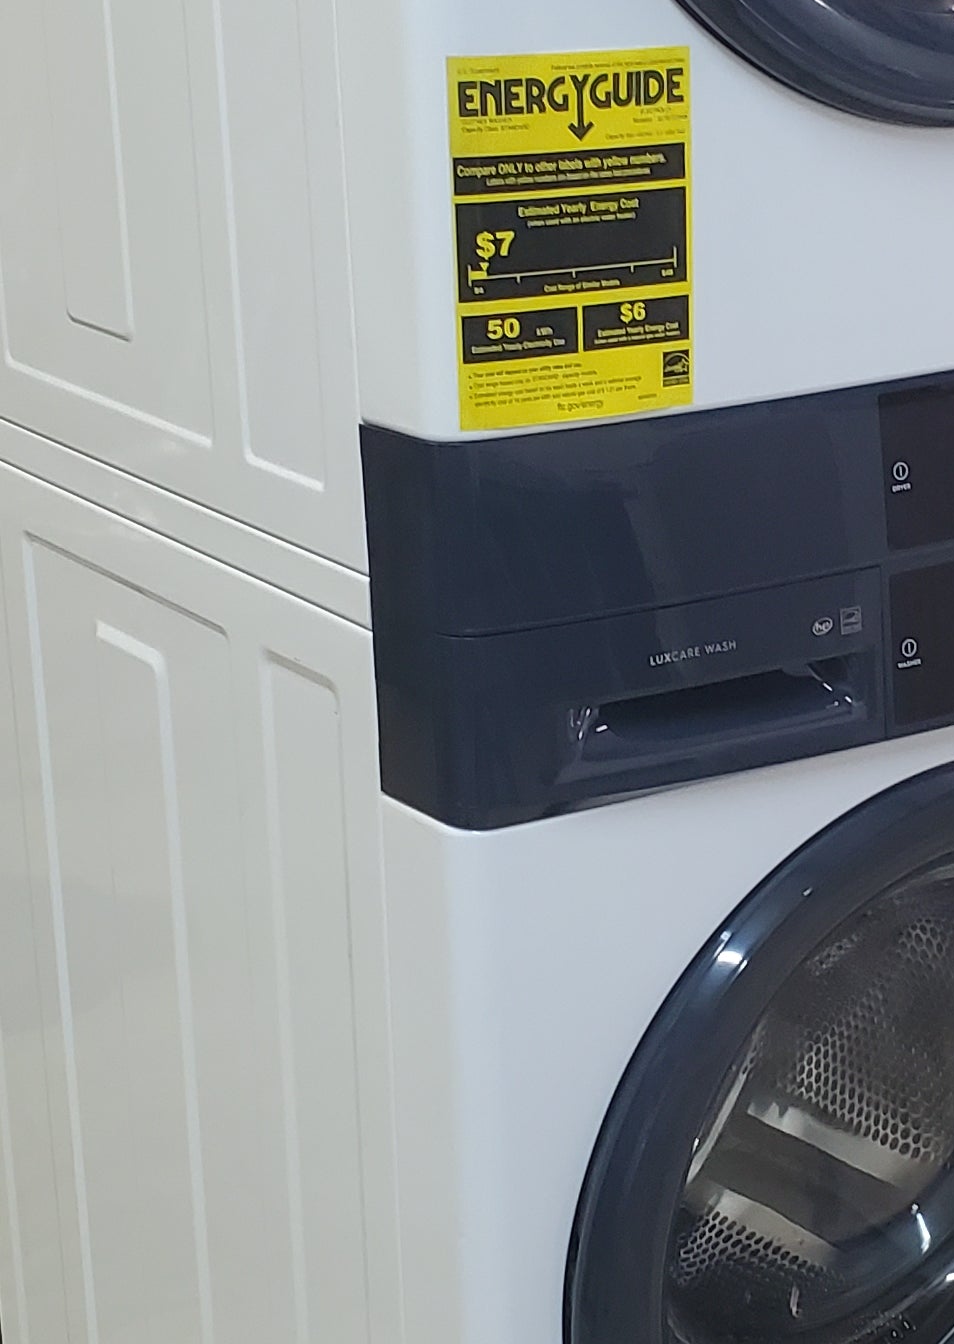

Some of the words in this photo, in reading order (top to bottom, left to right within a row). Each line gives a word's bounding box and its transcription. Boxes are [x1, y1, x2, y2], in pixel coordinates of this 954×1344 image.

[457, 67, 685, 120] ENERGYGUIDE
[457, 165, 497, 179] Compare
[498, 162, 523, 175] ONLY
[524, 163, 534, 173] to
[535, 161, 557, 172] other
[561, 202, 587, 215] Yearly
[590, 200, 618, 212] Energy
[620, 198, 639, 209] Cost
[476, 230, 515, 260] $7
[620, 301, 646, 324] $6
[487, 317, 520, 340] 50
[649, 646, 701, 667] LUXCARE
[704, 640, 737, 655] WASH
